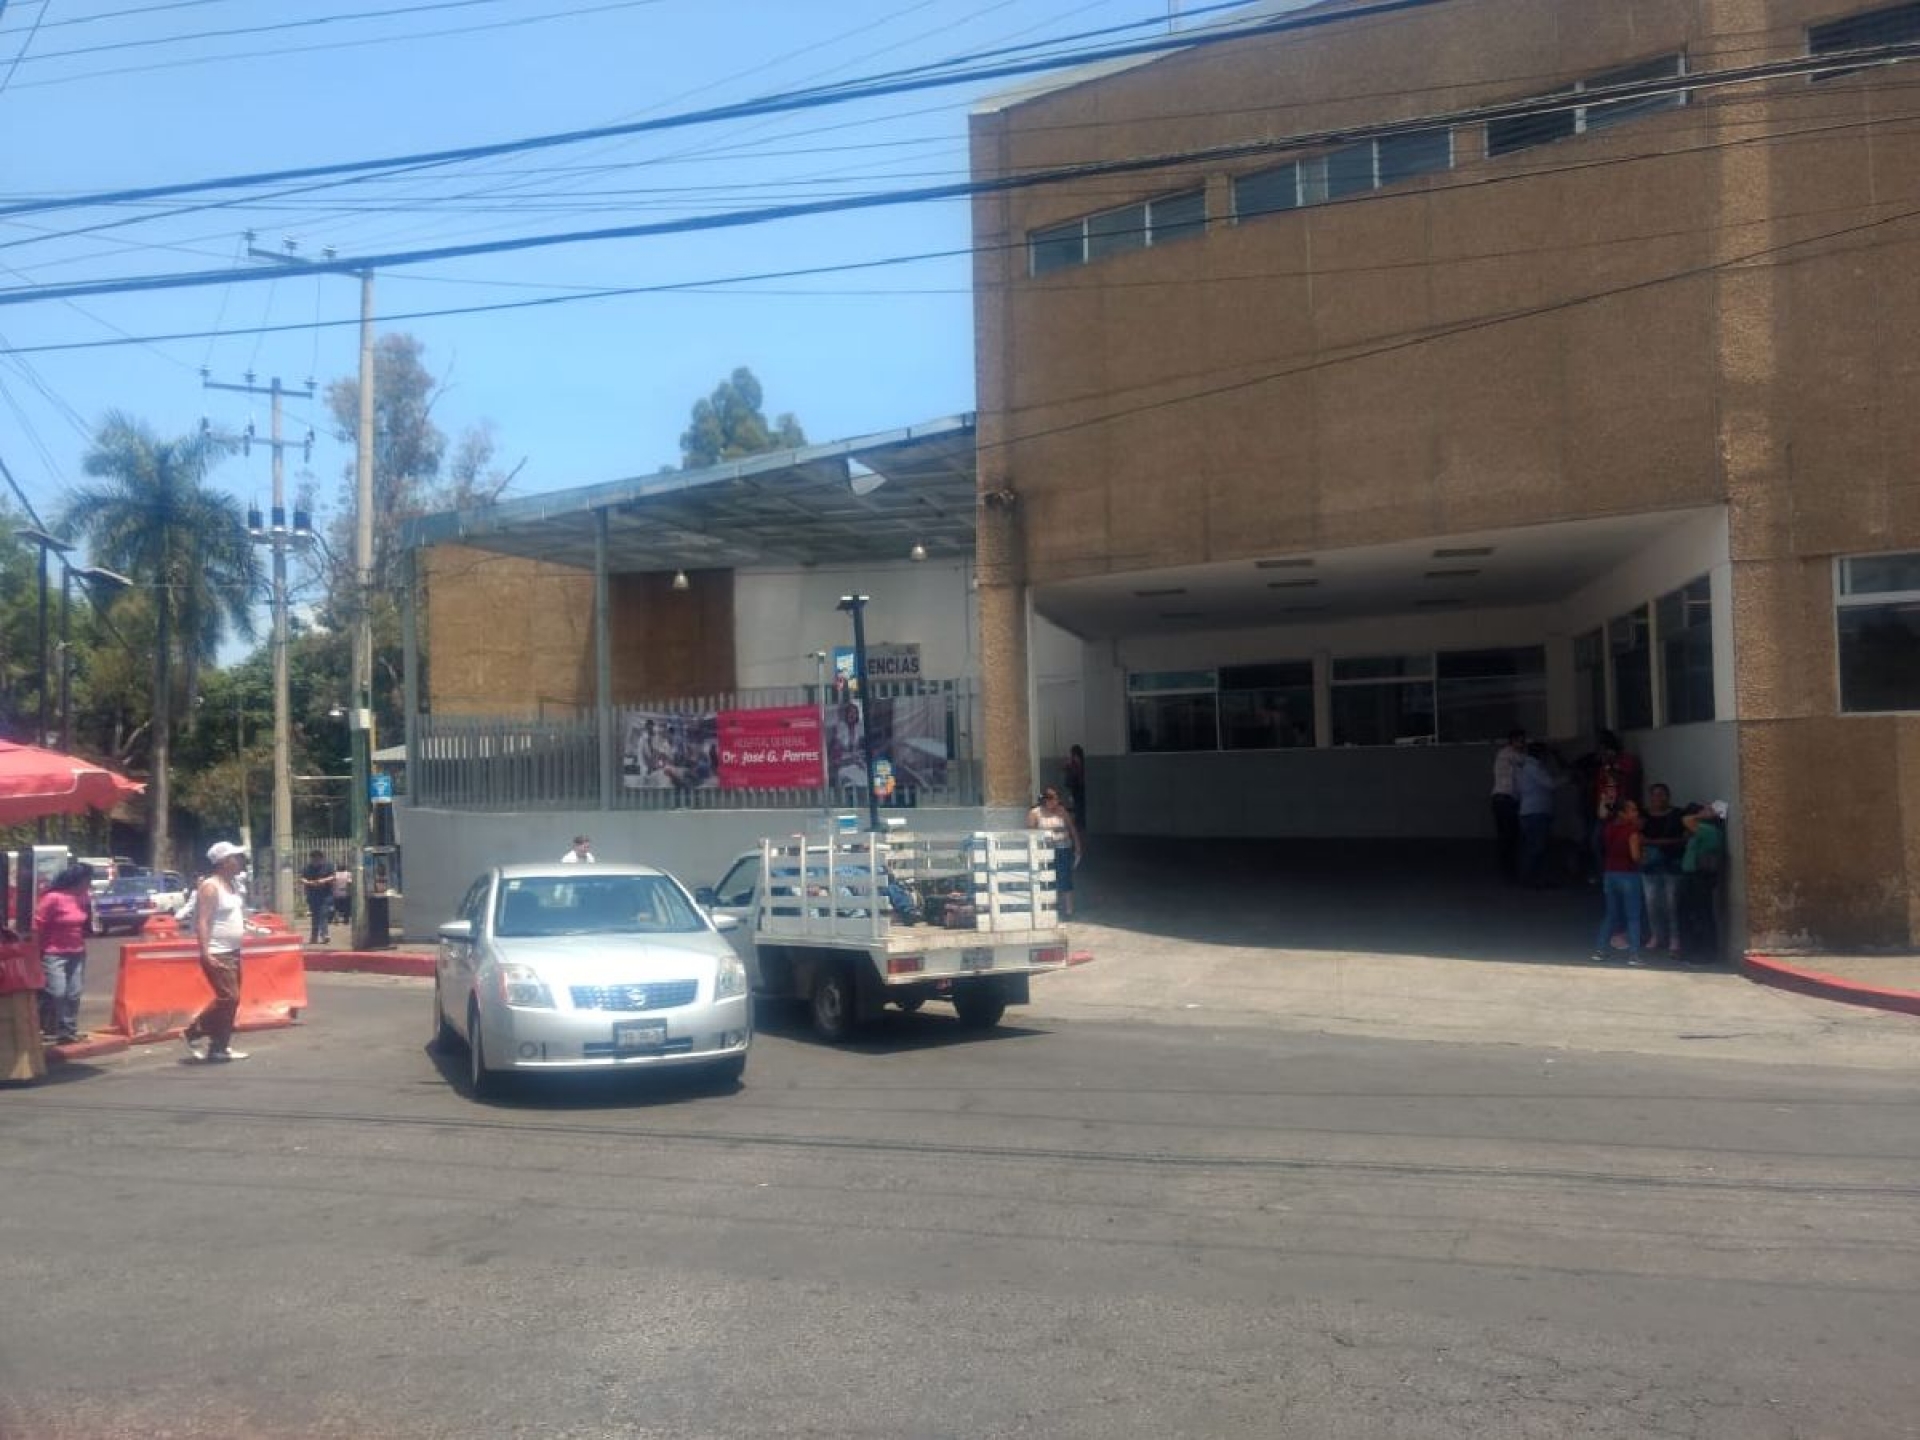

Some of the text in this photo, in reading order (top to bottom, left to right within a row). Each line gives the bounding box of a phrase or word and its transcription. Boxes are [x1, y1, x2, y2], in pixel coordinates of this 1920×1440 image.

[867, 657, 919, 675] ENCIAS
[722, 751, 738, 763] Dr.
[741, 749, 765, 766] José
